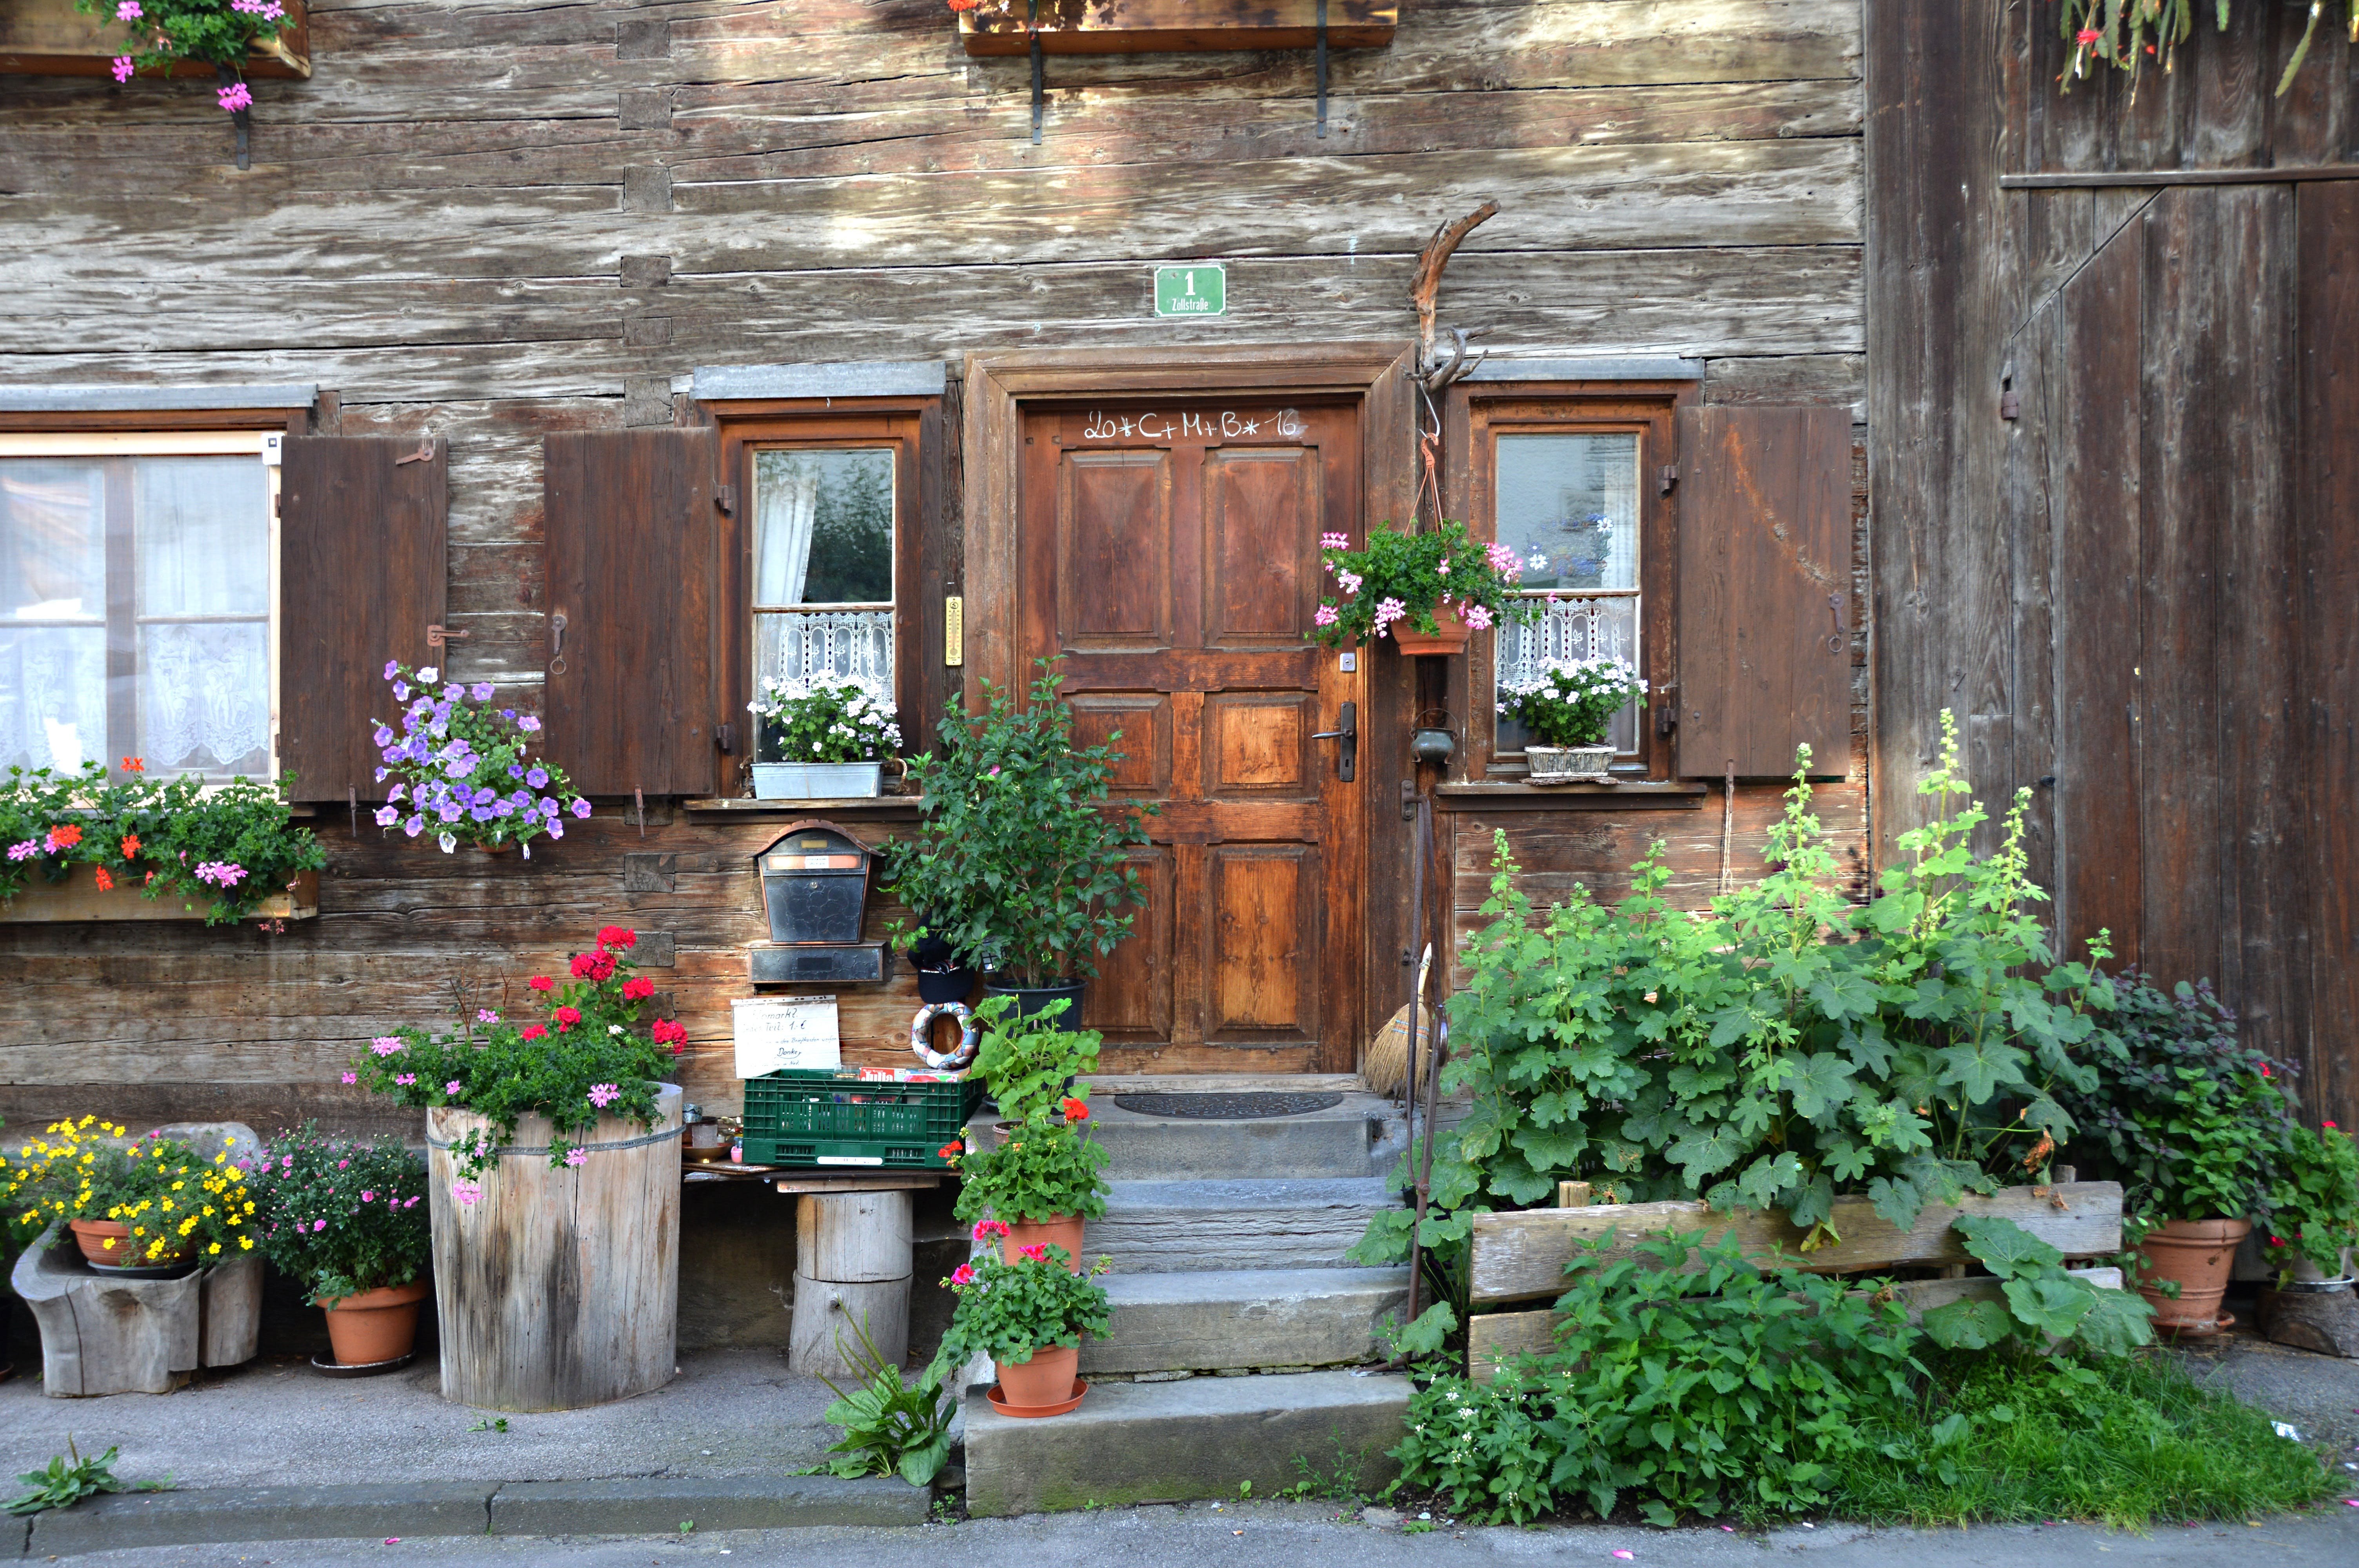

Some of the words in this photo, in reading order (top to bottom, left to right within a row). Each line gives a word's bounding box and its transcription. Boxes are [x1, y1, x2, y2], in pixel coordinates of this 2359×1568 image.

[1185, 271, 1196, 295] 1
[1172, 298, 1208, 311] Zollstraße
[861, 1071, 893, 1082] Julia
